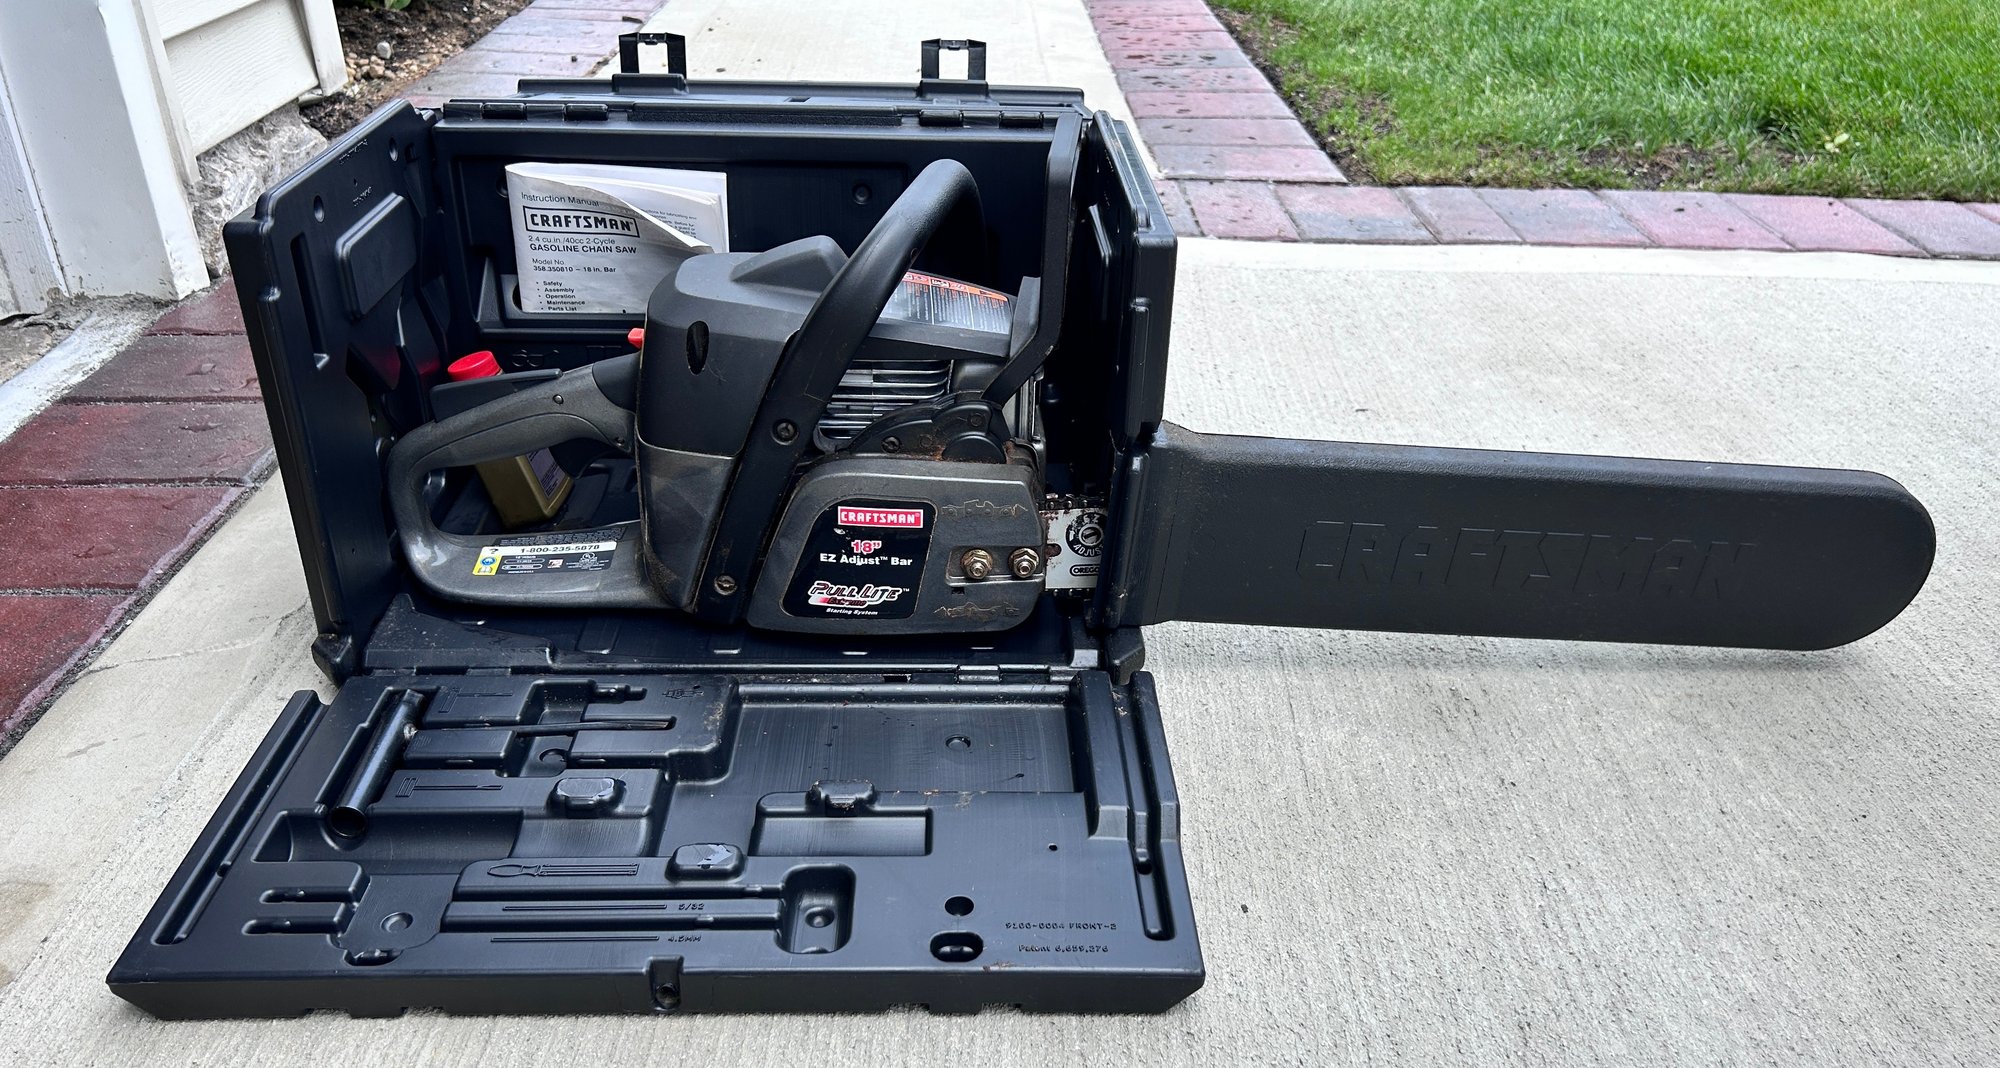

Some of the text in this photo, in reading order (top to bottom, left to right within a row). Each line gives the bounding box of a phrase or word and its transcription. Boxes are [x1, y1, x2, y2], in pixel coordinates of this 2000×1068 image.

[521, 192, 600, 207] Instruction Manual
[586, 237, 616, 246] 2-Cycle
[529, 243, 637, 254] GASOLINE CHAIN SAW
[820, 553, 837, 563] EZ
[891, 556, 913, 566] Bar
[1295, 519, 1758, 600] CRAFTSMAN
[808, 580, 858, 597] PULL
[826, 607, 853, 615] Starting
[1018, 944, 1051, 953] Patent
